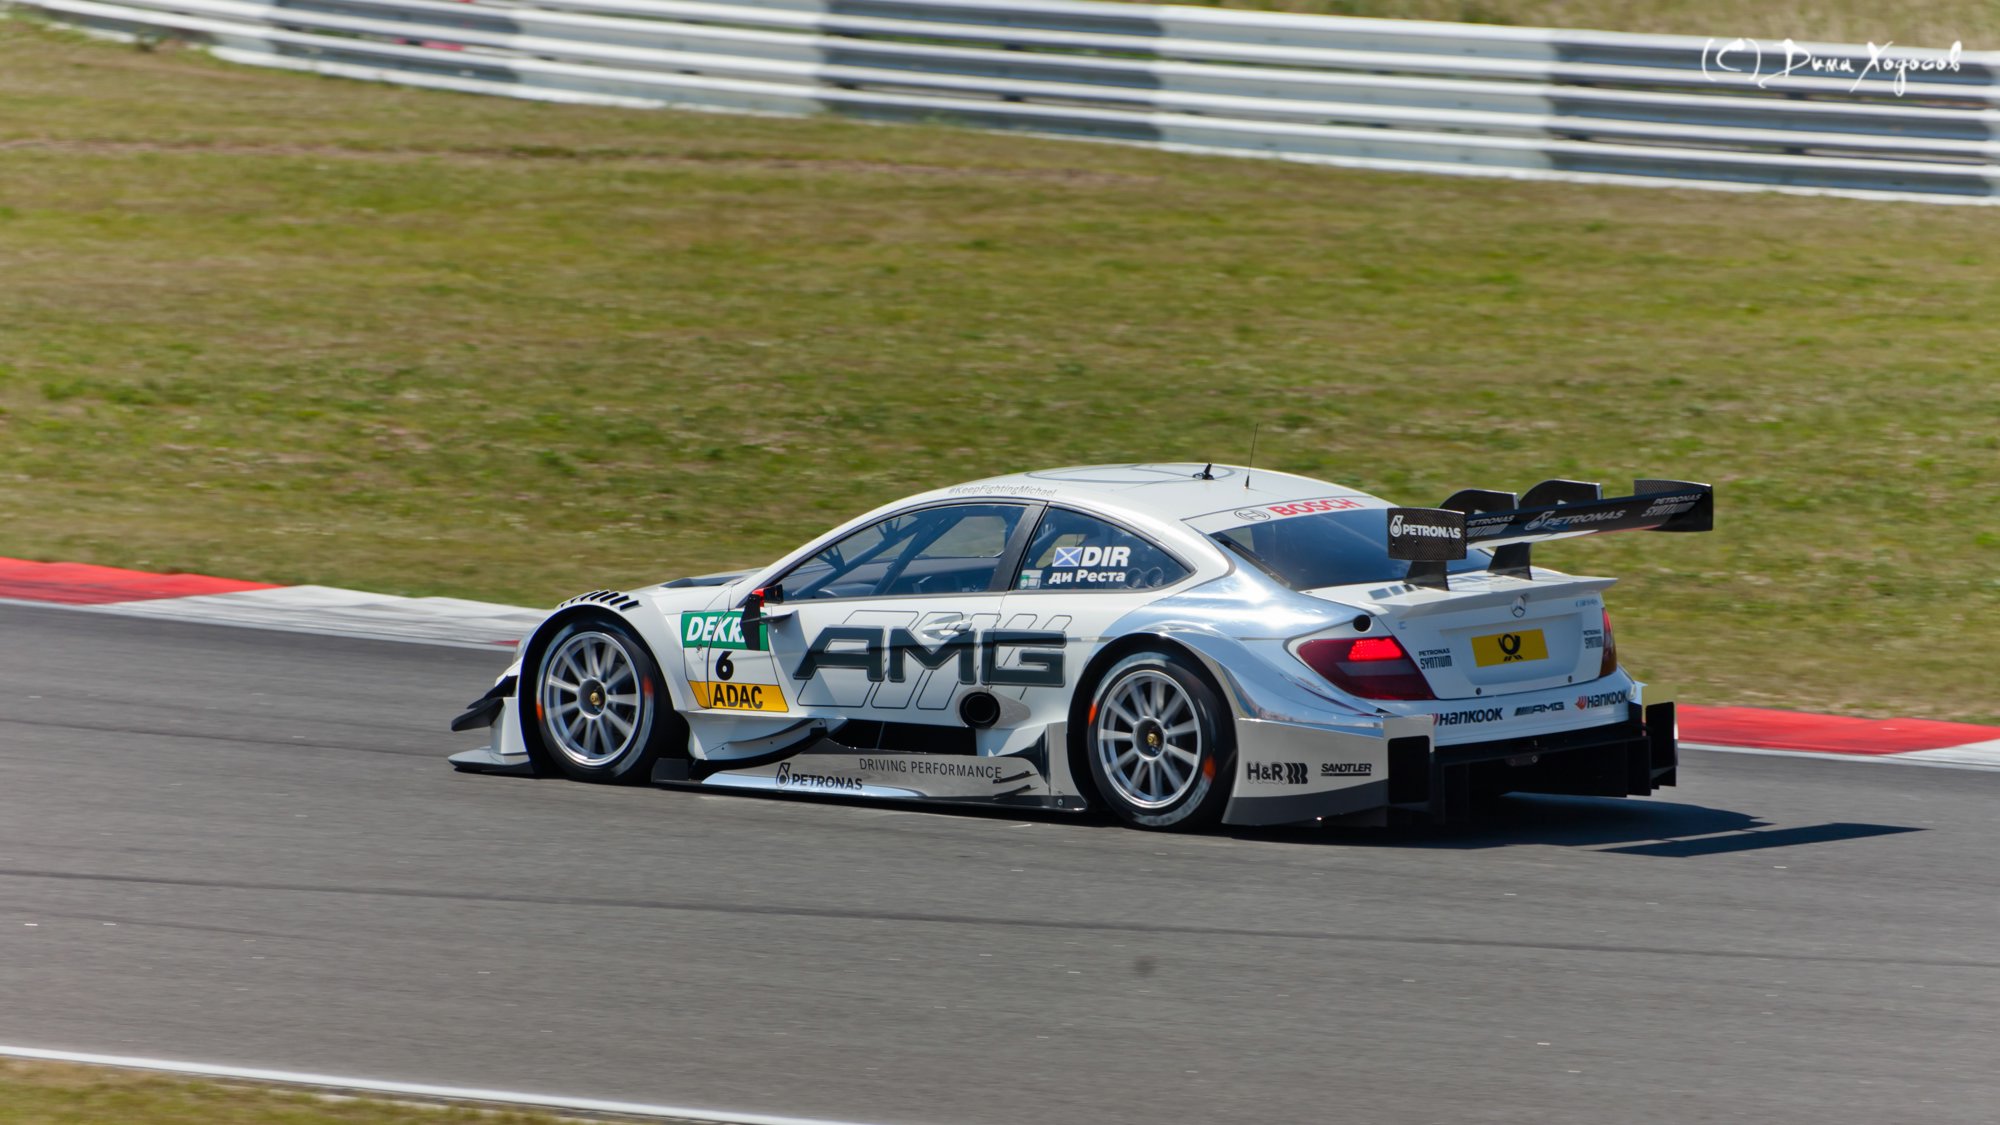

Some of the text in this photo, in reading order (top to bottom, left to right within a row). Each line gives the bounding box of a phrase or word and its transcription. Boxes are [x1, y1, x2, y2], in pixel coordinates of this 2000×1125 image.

[1267, 498, 1365, 516] BOSCH
[1543, 510, 1627, 527] PETRONAS
[1402, 524, 1462, 539] PETRONAS
[1080, 546, 1131, 567] DIR
[1048, 572, 1073, 584] ди
[1075, 569, 1126, 583] Реста
[686, 616, 746, 643] DEKR
[792, 624, 1067, 687] AMG
[1419, 648, 1450, 656] PETRONAS
[715, 651, 734, 681] 6
[713, 684, 764, 709] ADAC
[1531, 701, 1565, 713] AMG
[859, 758, 1003, 779] DRIVING PERFORMANCE
[1246, 761, 1285, 781] H&R
[1320, 763, 1373, 774] SANDTLER
[791, 772, 863, 790] PETRONAS
